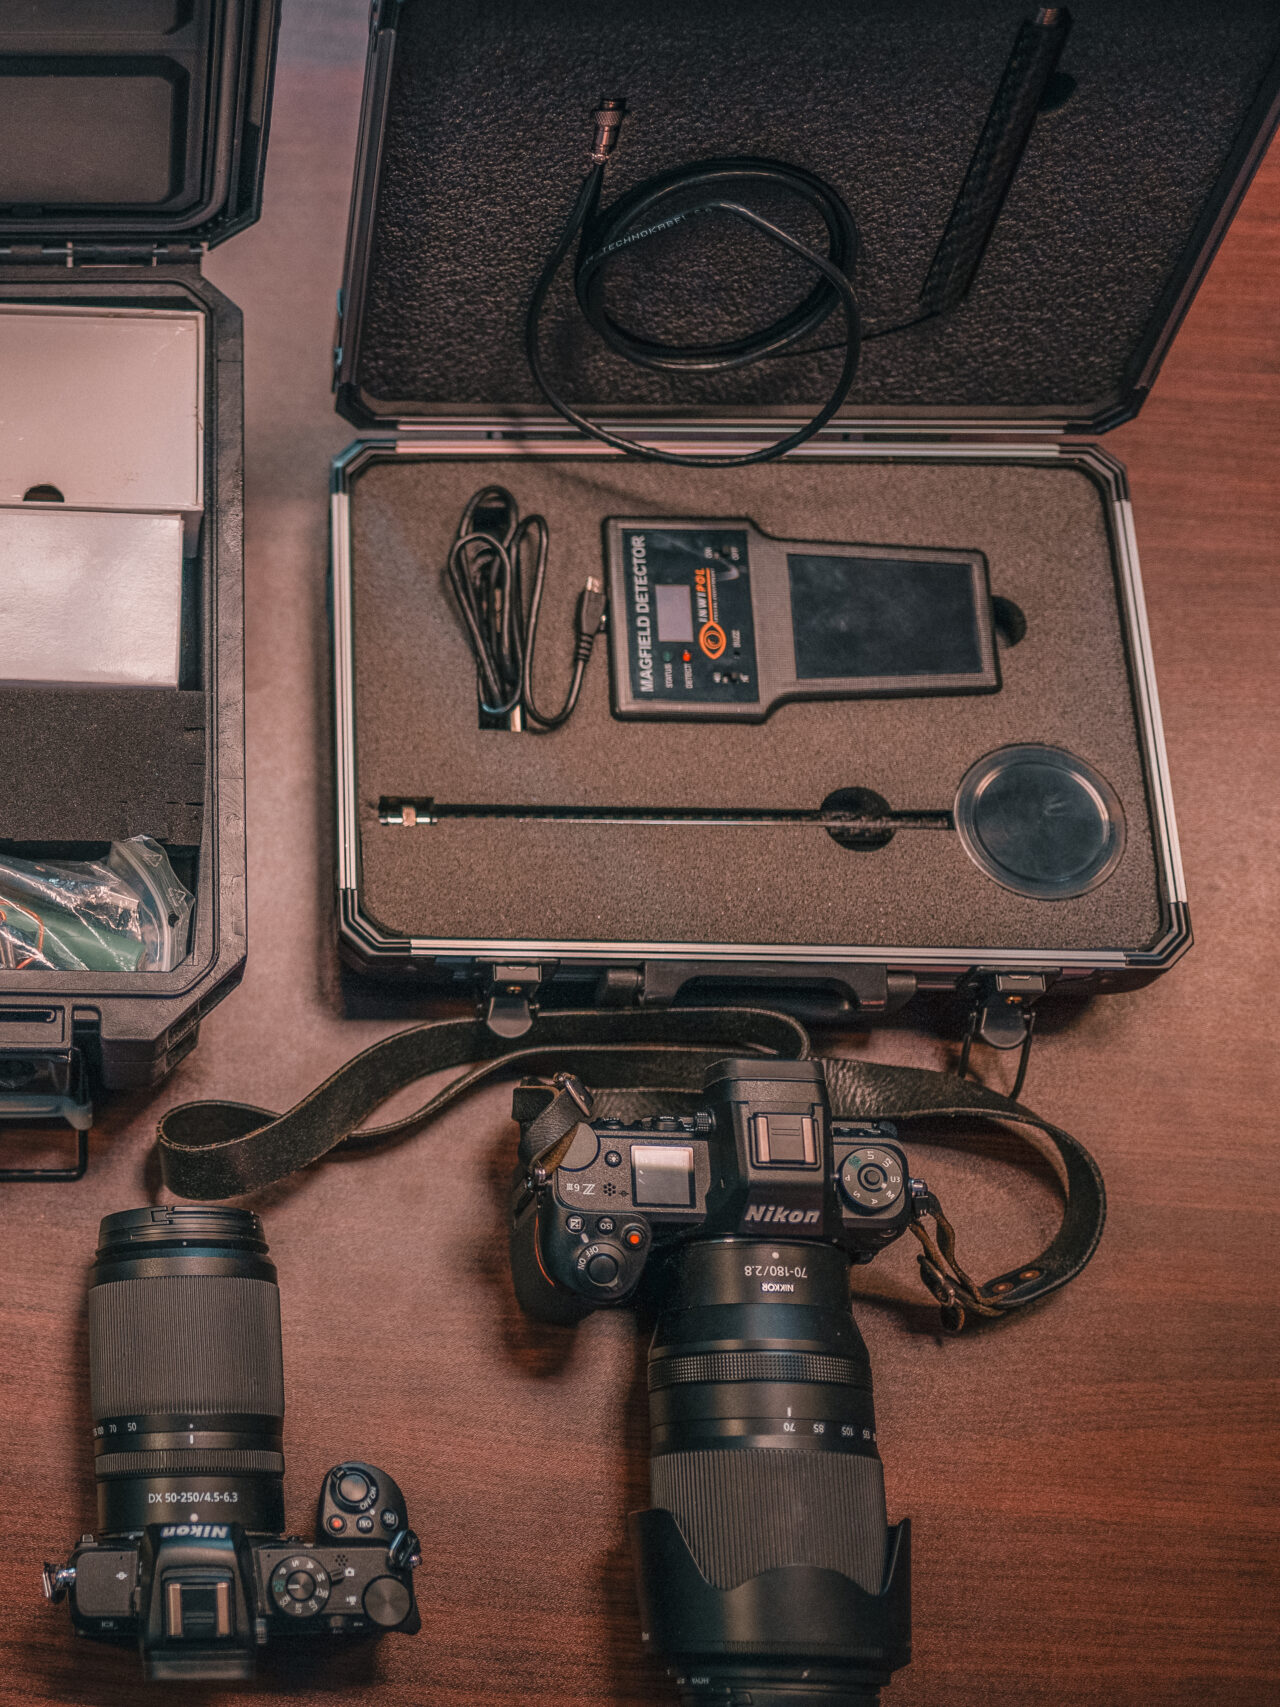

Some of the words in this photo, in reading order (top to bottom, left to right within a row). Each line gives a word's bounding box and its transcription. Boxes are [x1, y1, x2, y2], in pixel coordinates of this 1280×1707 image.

[630, 534, 651, 614] DETECTOR
[694, 567, 708, 623] INWIPOL
[636, 615, 655, 693] MAGFIELD
[664, 662, 674, 689] STATUS
[684, 662, 694, 690] DETECT
[882, 1157, 894, 1168] U2
[889, 1175, 901, 1183] U3
[885, 1190, 896, 1200] M
[744, 1204, 820, 1223] Nikon
[599, 1222, 613, 1230] ISO
[585, 1245, 599, 1257] OFF
[577, 1258, 586, 1271] ON
[744, 1265, 808, 1279] 70-180/2.8
[761, 1282, 795, 1293] NIKKOR
[109, 1424, 117, 1433] 70
[127, 1422, 137, 1432] 50
[783, 1422, 796, 1432] 70
[813, 1423, 825, 1434] 85
[841, 1426, 854, 1437] 105
[148, 1492, 163, 1504] DX
[165, 1491, 239, 1503] 50-250/4.5-6.3
[359, 1520, 372, 1528] ISO
[161, 1525, 229, 1538] Nikon
[316, 1572, 326, 1582] M
